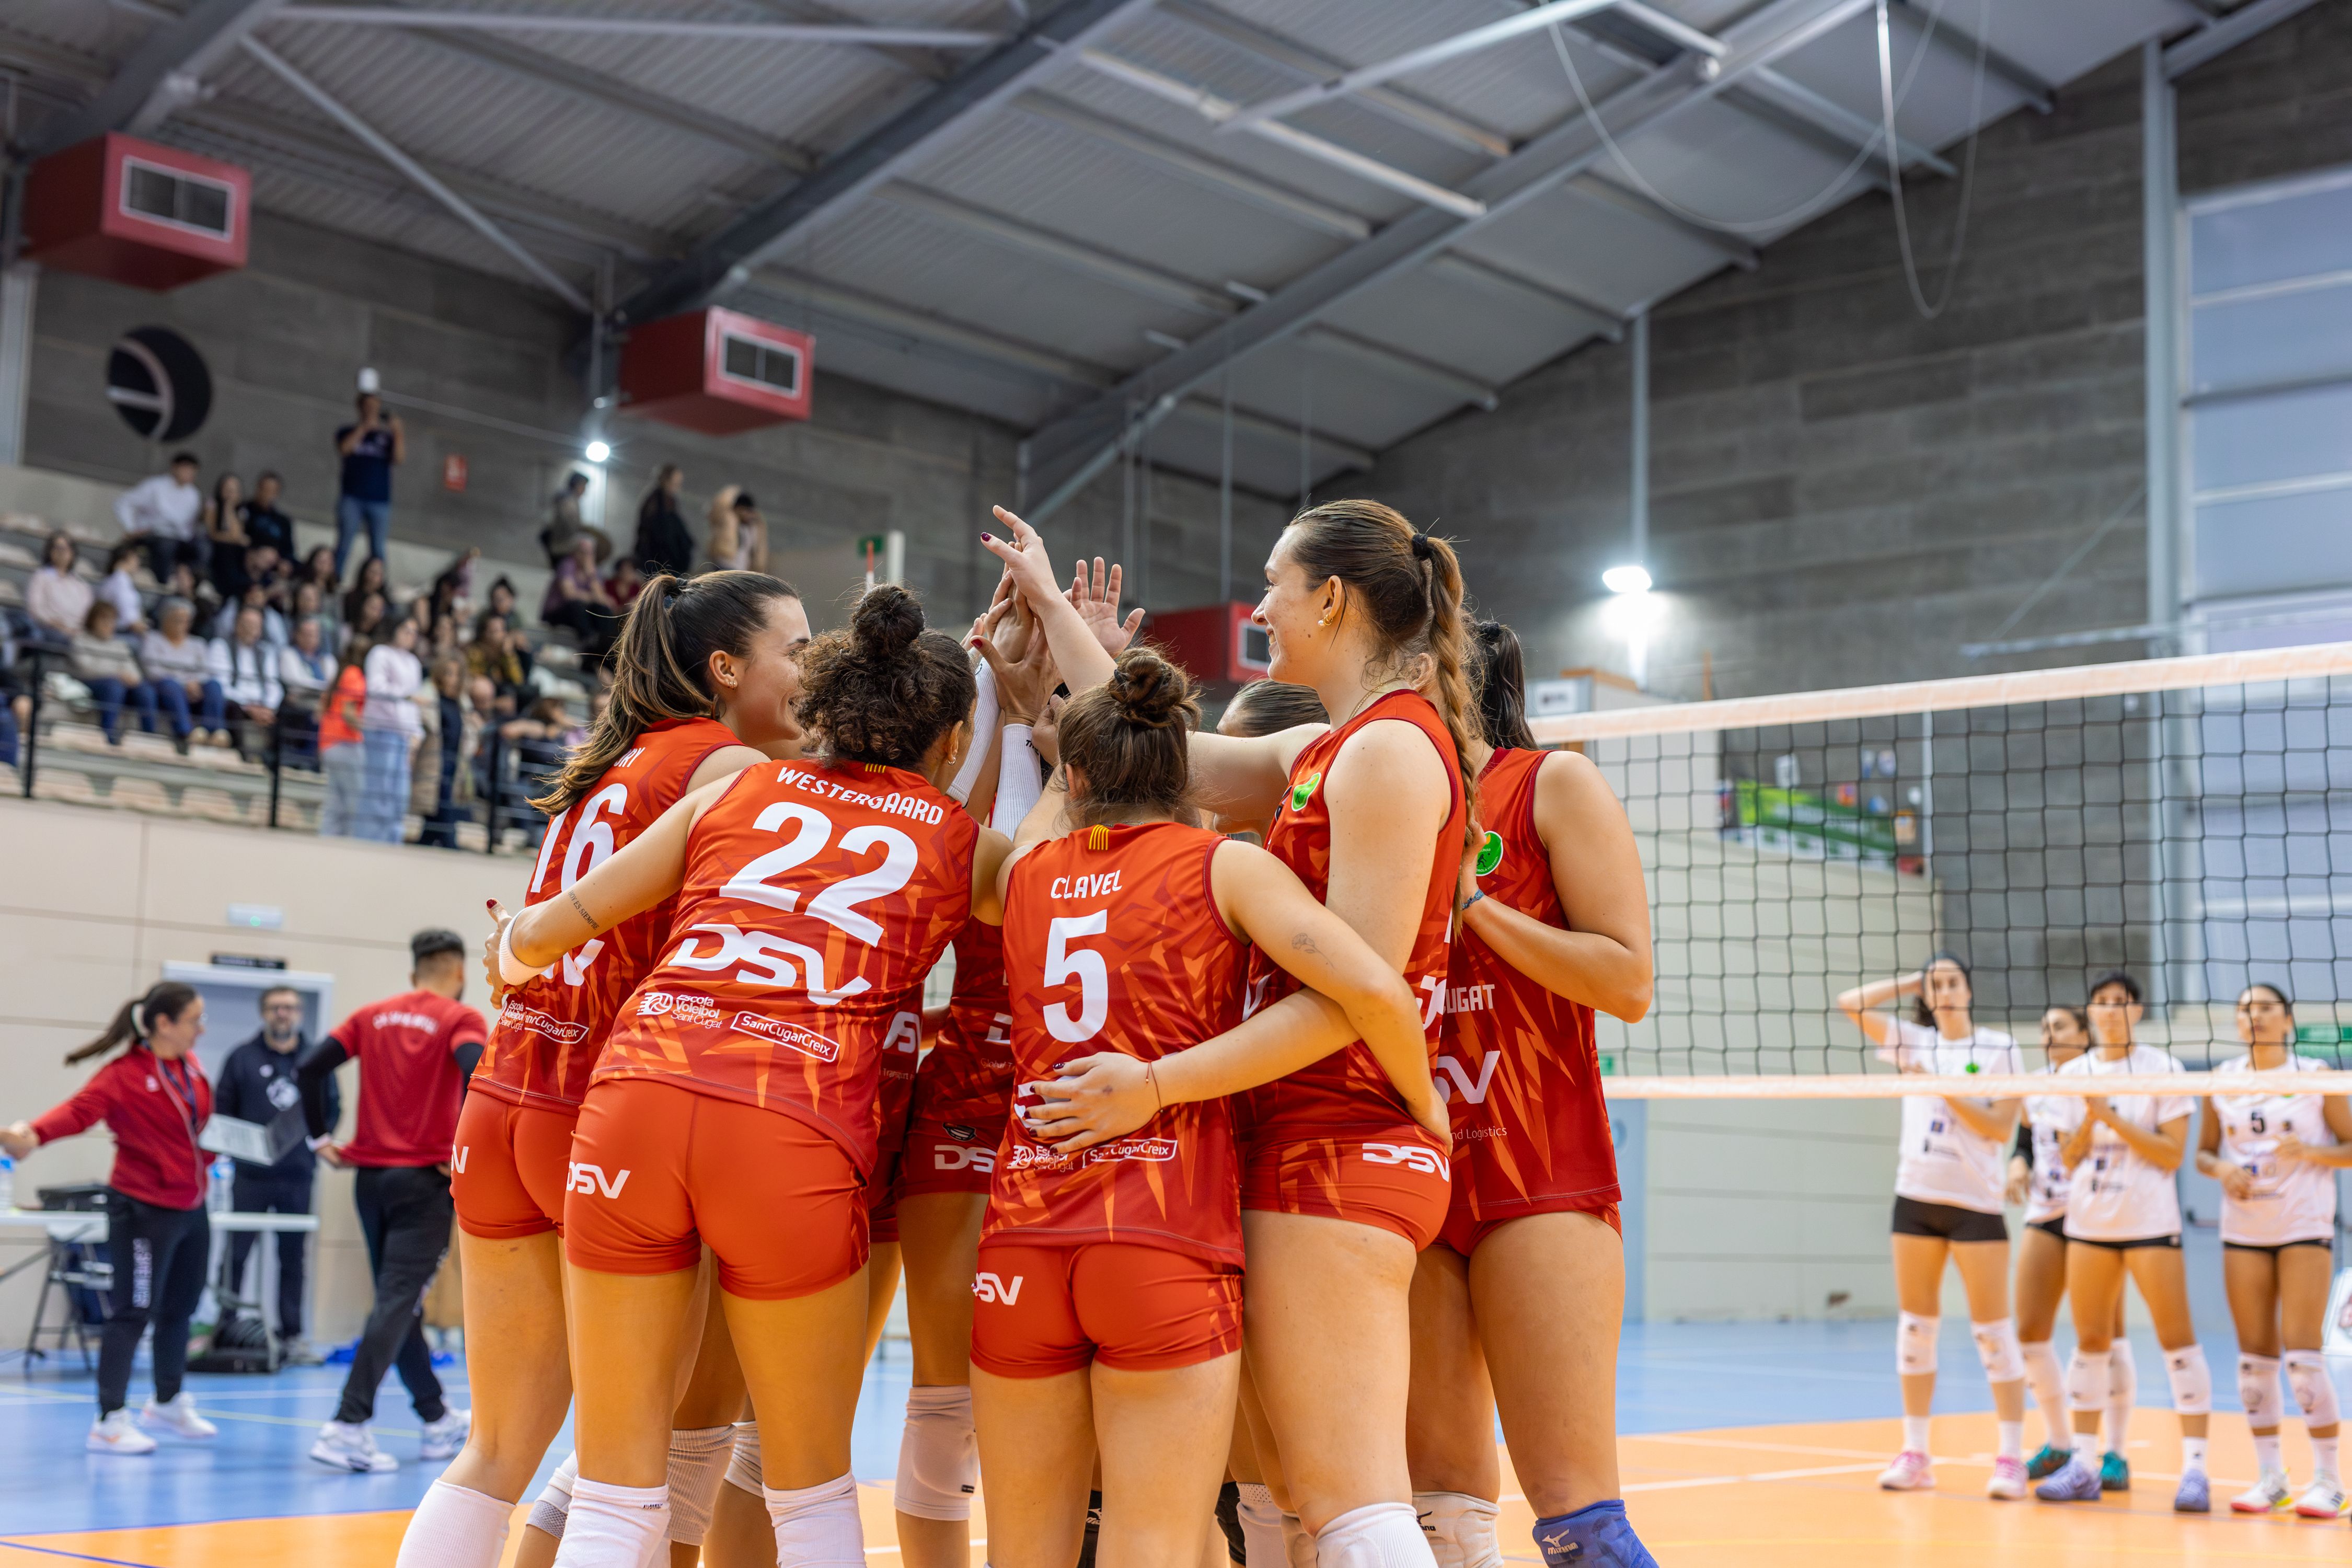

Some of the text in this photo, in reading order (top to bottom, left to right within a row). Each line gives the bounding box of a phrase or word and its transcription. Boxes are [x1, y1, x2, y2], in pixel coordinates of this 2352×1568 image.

[777, 767, 943, 825] WESTERGAARD
[530, 783, 628, 893] 16
[719, 802, 918, 947] 22
[1051, 869, 1122, 900] CLAVEL
[573, 901, 582, 909] ES
[579, 908, 599, 930] SIEMPRE
[667, 924, 871, 1005] DSV
[1043, 909, 1109, 1043] 5
[676, 994, 714, 1007] Escola
[676, 1000, 721, 1019] Voleibol
[1443, 984, 1495, 1014] UGAT
[525, 1013, 579, 1037] antCugatCreix
[671, 1009, 723, 1029] Sant Cugat
[1451, 1125, 1507, 1141] nd Logistics
[2251, 1111, 2266, 1134] 5
